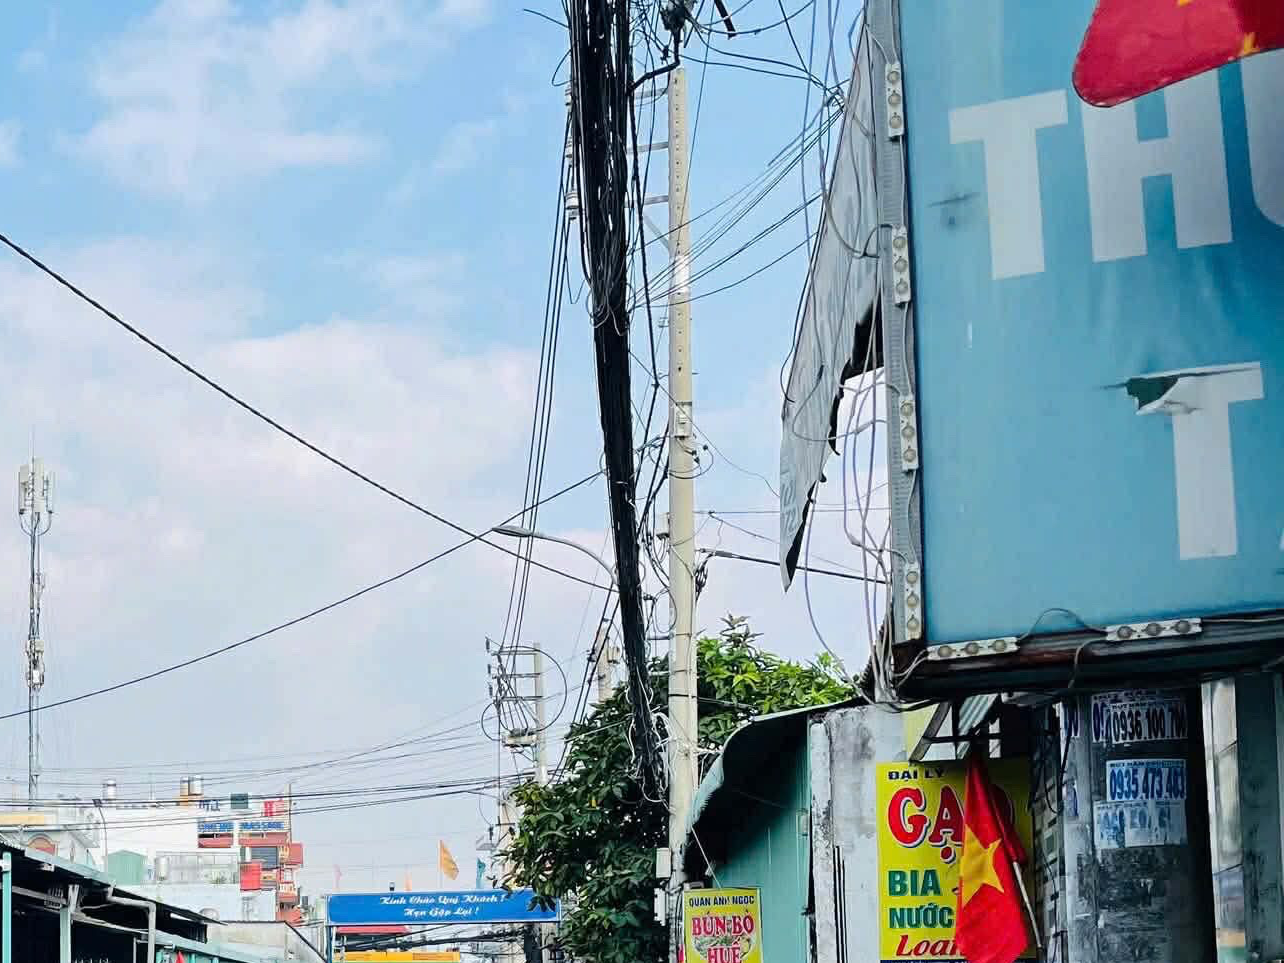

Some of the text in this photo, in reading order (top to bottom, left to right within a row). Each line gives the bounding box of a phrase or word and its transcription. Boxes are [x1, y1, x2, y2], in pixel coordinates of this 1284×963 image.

[1128, 360, 1284, 560] T
[887, 785, 1015, 864] GẠ
[888, 870, 941, 896] BIA
[889, 902, 954, 929] NƯỚC
